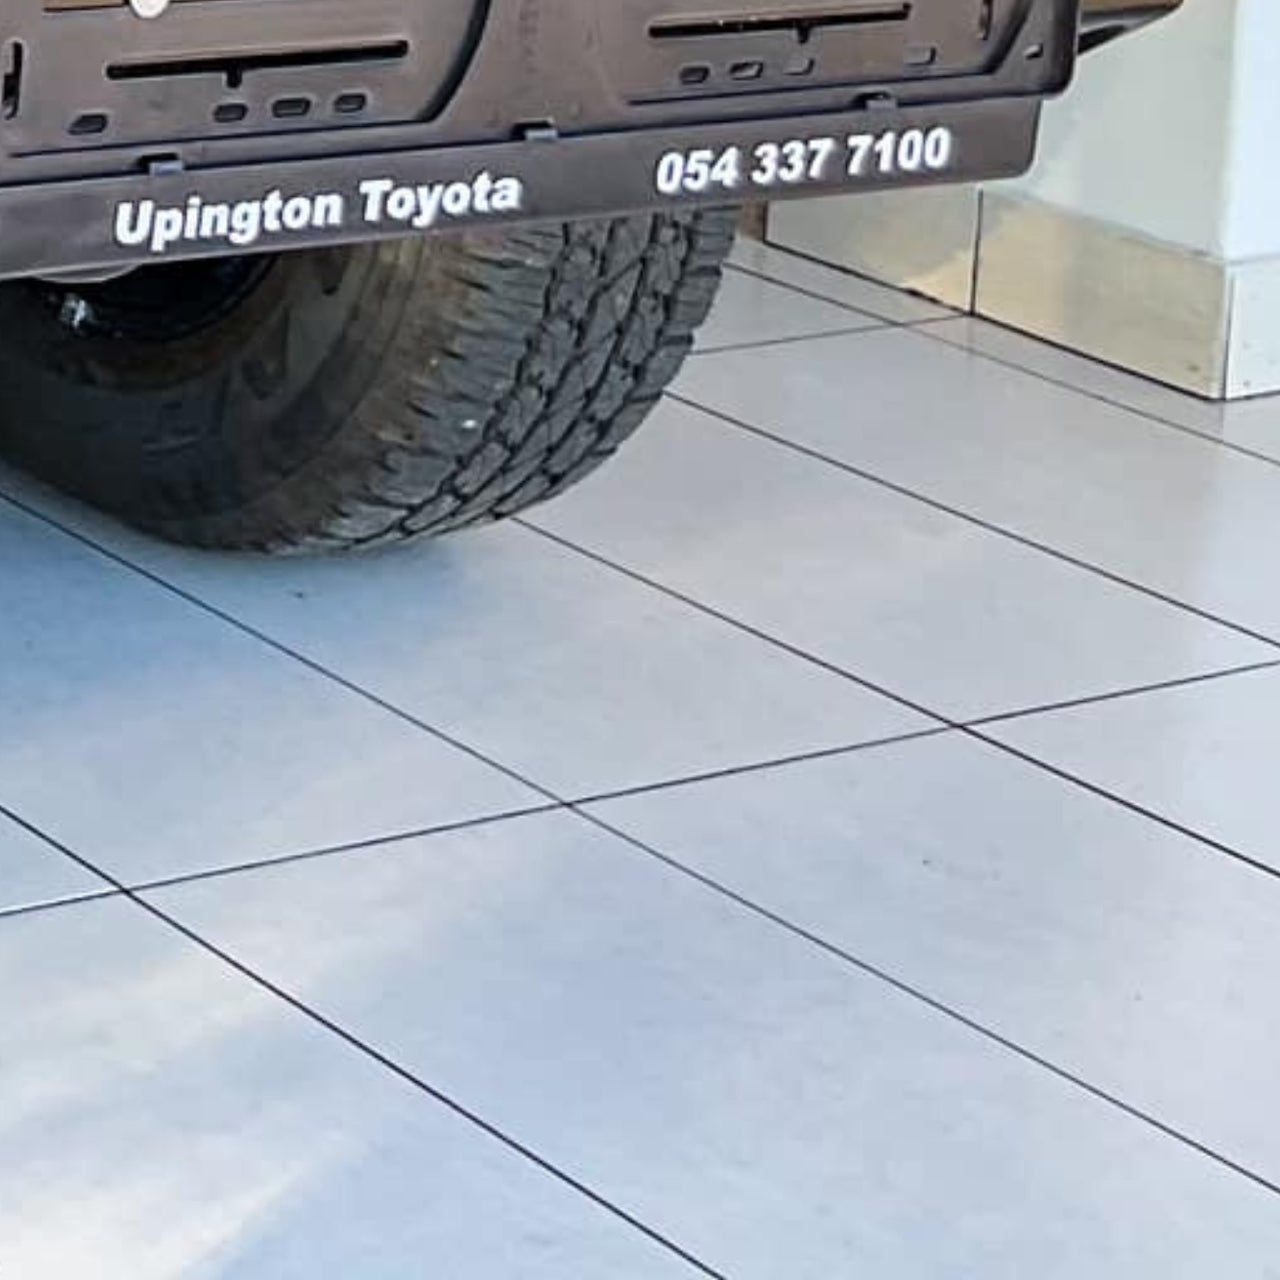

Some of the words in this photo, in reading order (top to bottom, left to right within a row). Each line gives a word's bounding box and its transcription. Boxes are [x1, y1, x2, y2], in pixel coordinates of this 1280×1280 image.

[656, 146, 739, 194] 054
[751, 138, 835, 185] 337
[847, 127, 952, 176] 7100
[115, 189, 342, 251] Upington
[359, 171, 523, 228] Toyota
